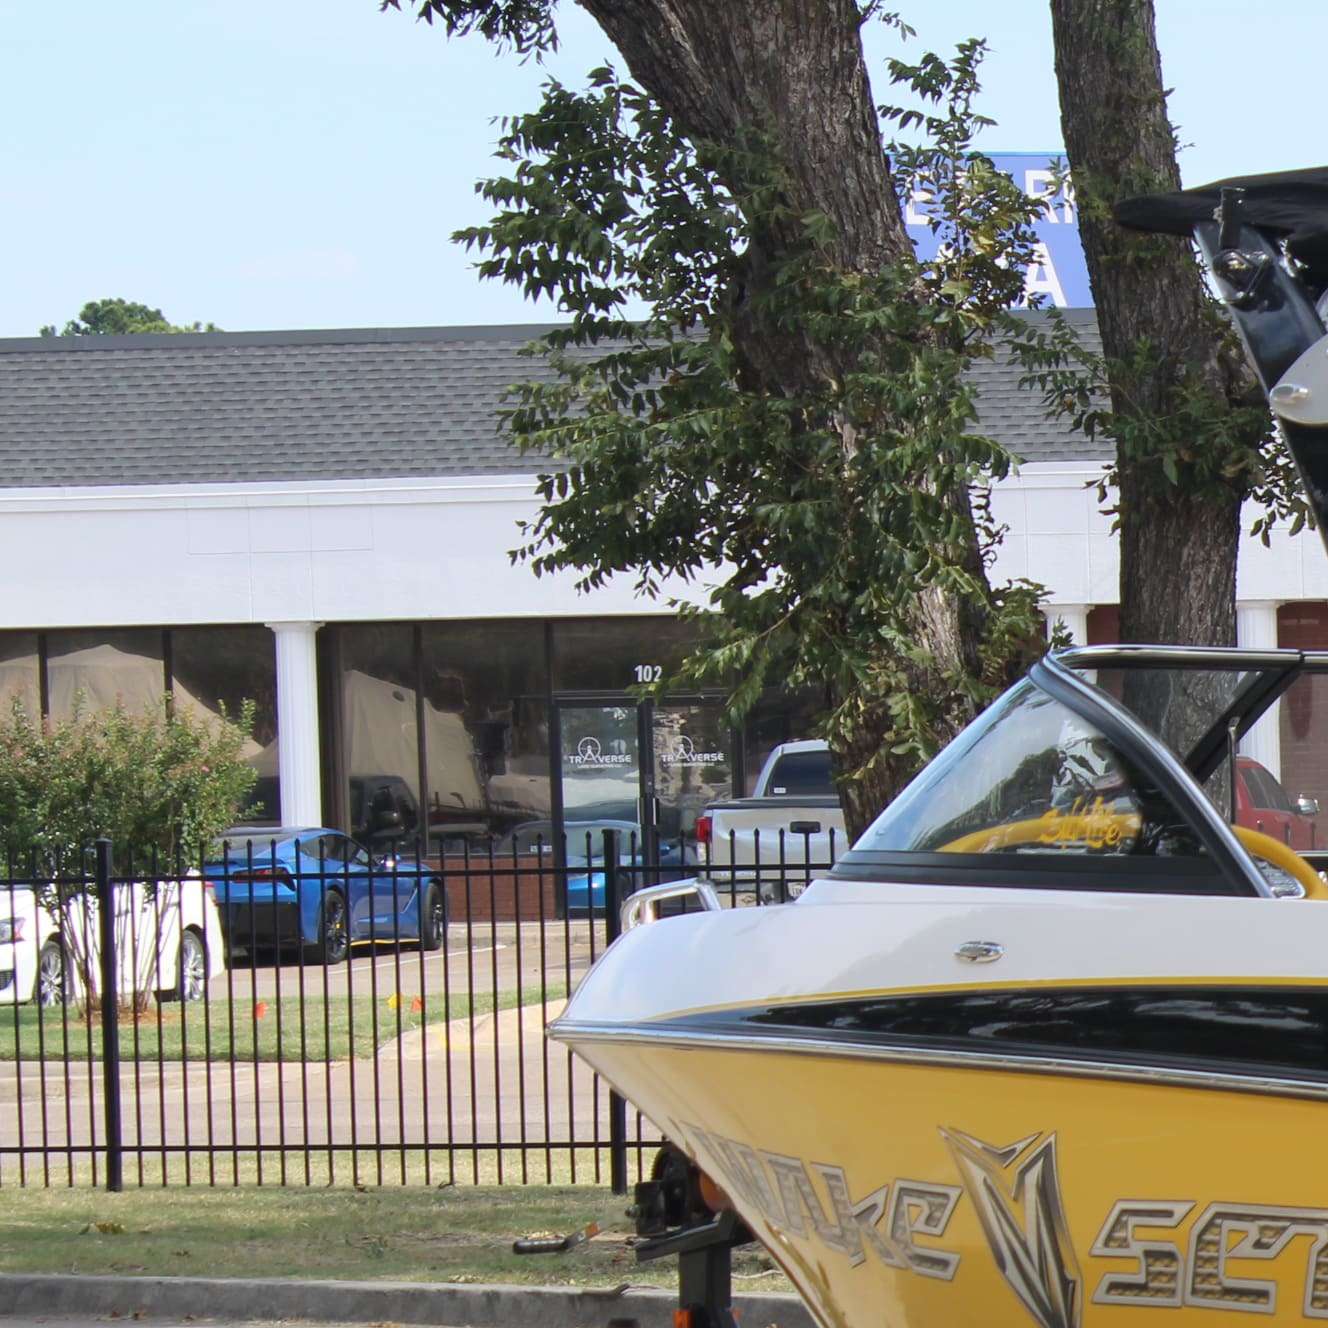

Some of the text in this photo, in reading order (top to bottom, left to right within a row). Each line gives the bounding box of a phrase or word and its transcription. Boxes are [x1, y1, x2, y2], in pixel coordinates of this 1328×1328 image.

[634, 665, 662, 682] 102
[569, 748, 632, 764] TRAVERSE
[661, 747, 725, 763] TRAVERSE
